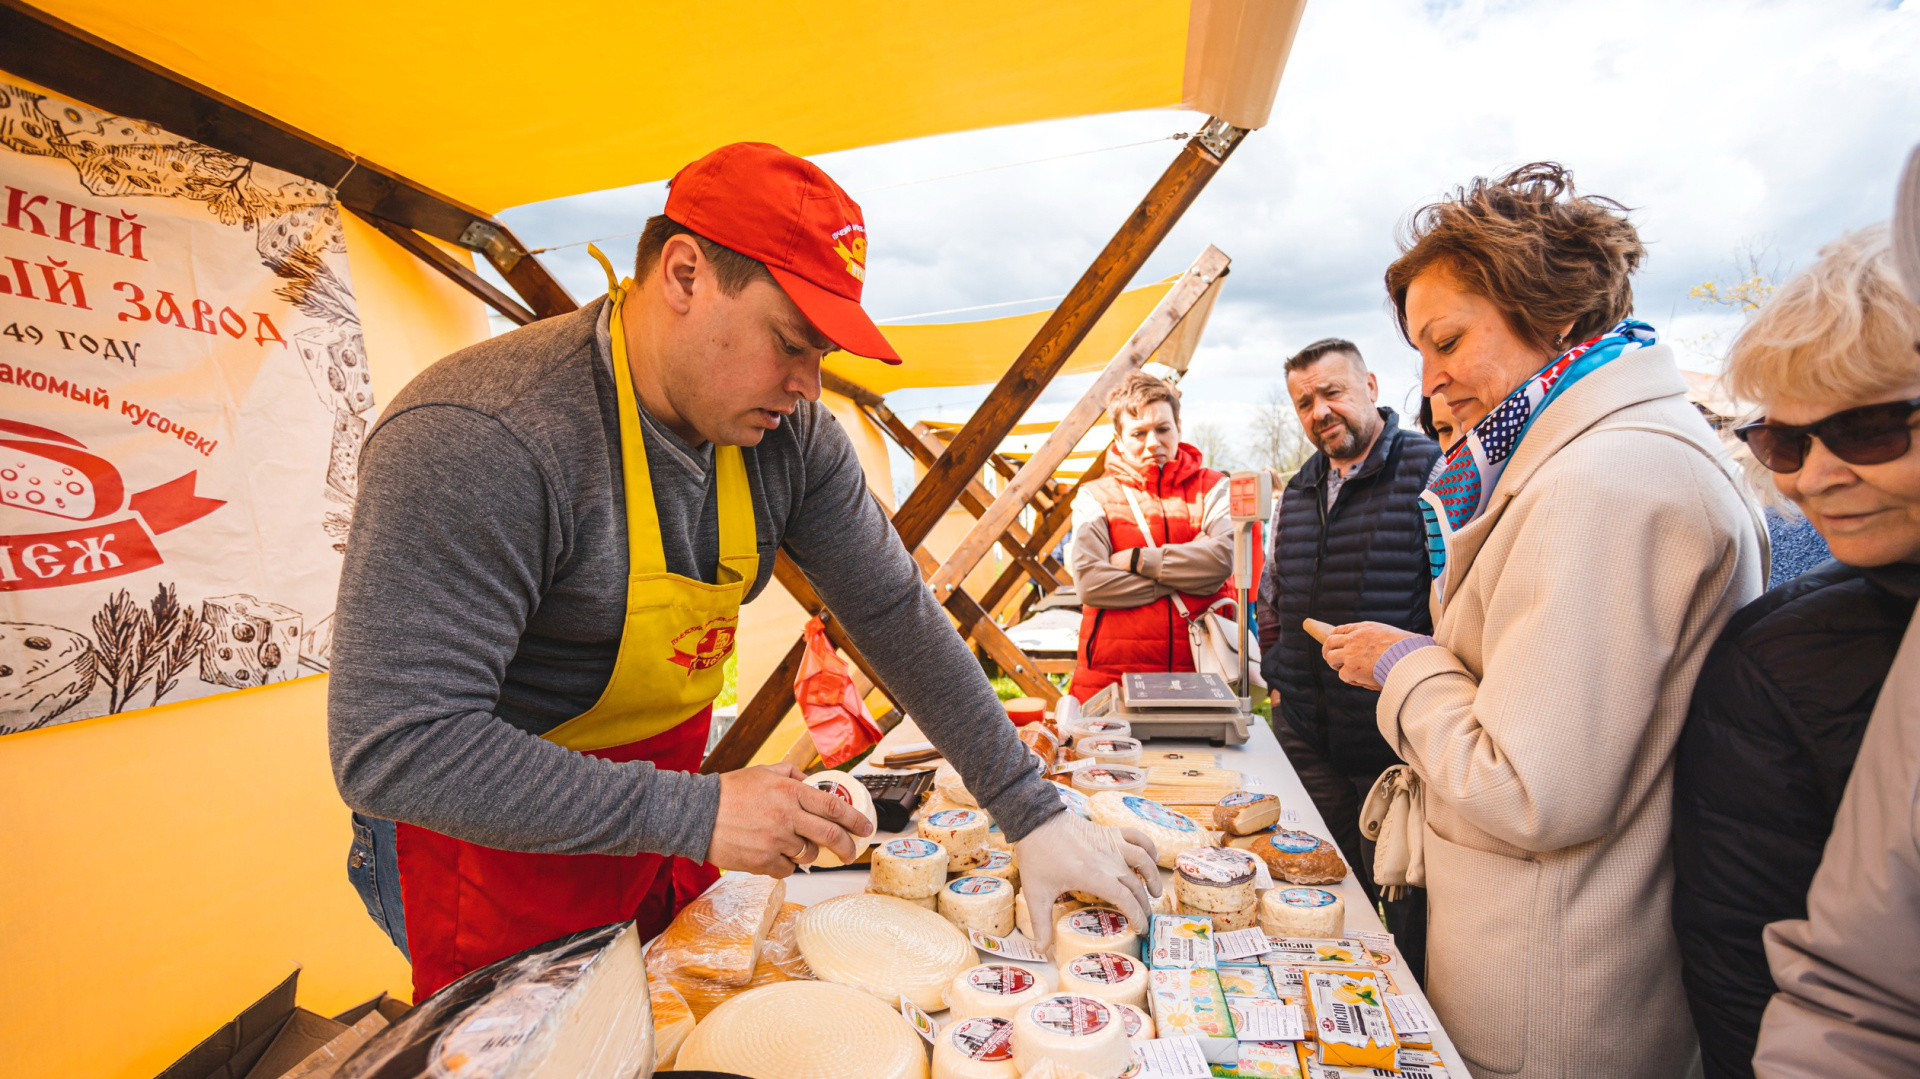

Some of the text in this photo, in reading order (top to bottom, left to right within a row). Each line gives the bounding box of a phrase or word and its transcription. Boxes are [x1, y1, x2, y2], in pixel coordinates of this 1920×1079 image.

[1, 185, 149, 262] КИЙ
[3, 322, 44, 346] 49
[112, 281, 288, 350] ЗАВОД
[121, 400, 218, 457] кусочек!
[1332, 1003, 1351, 1034] МАСЛО
[1247, 1048, 1291, 1058] МАСЛО
